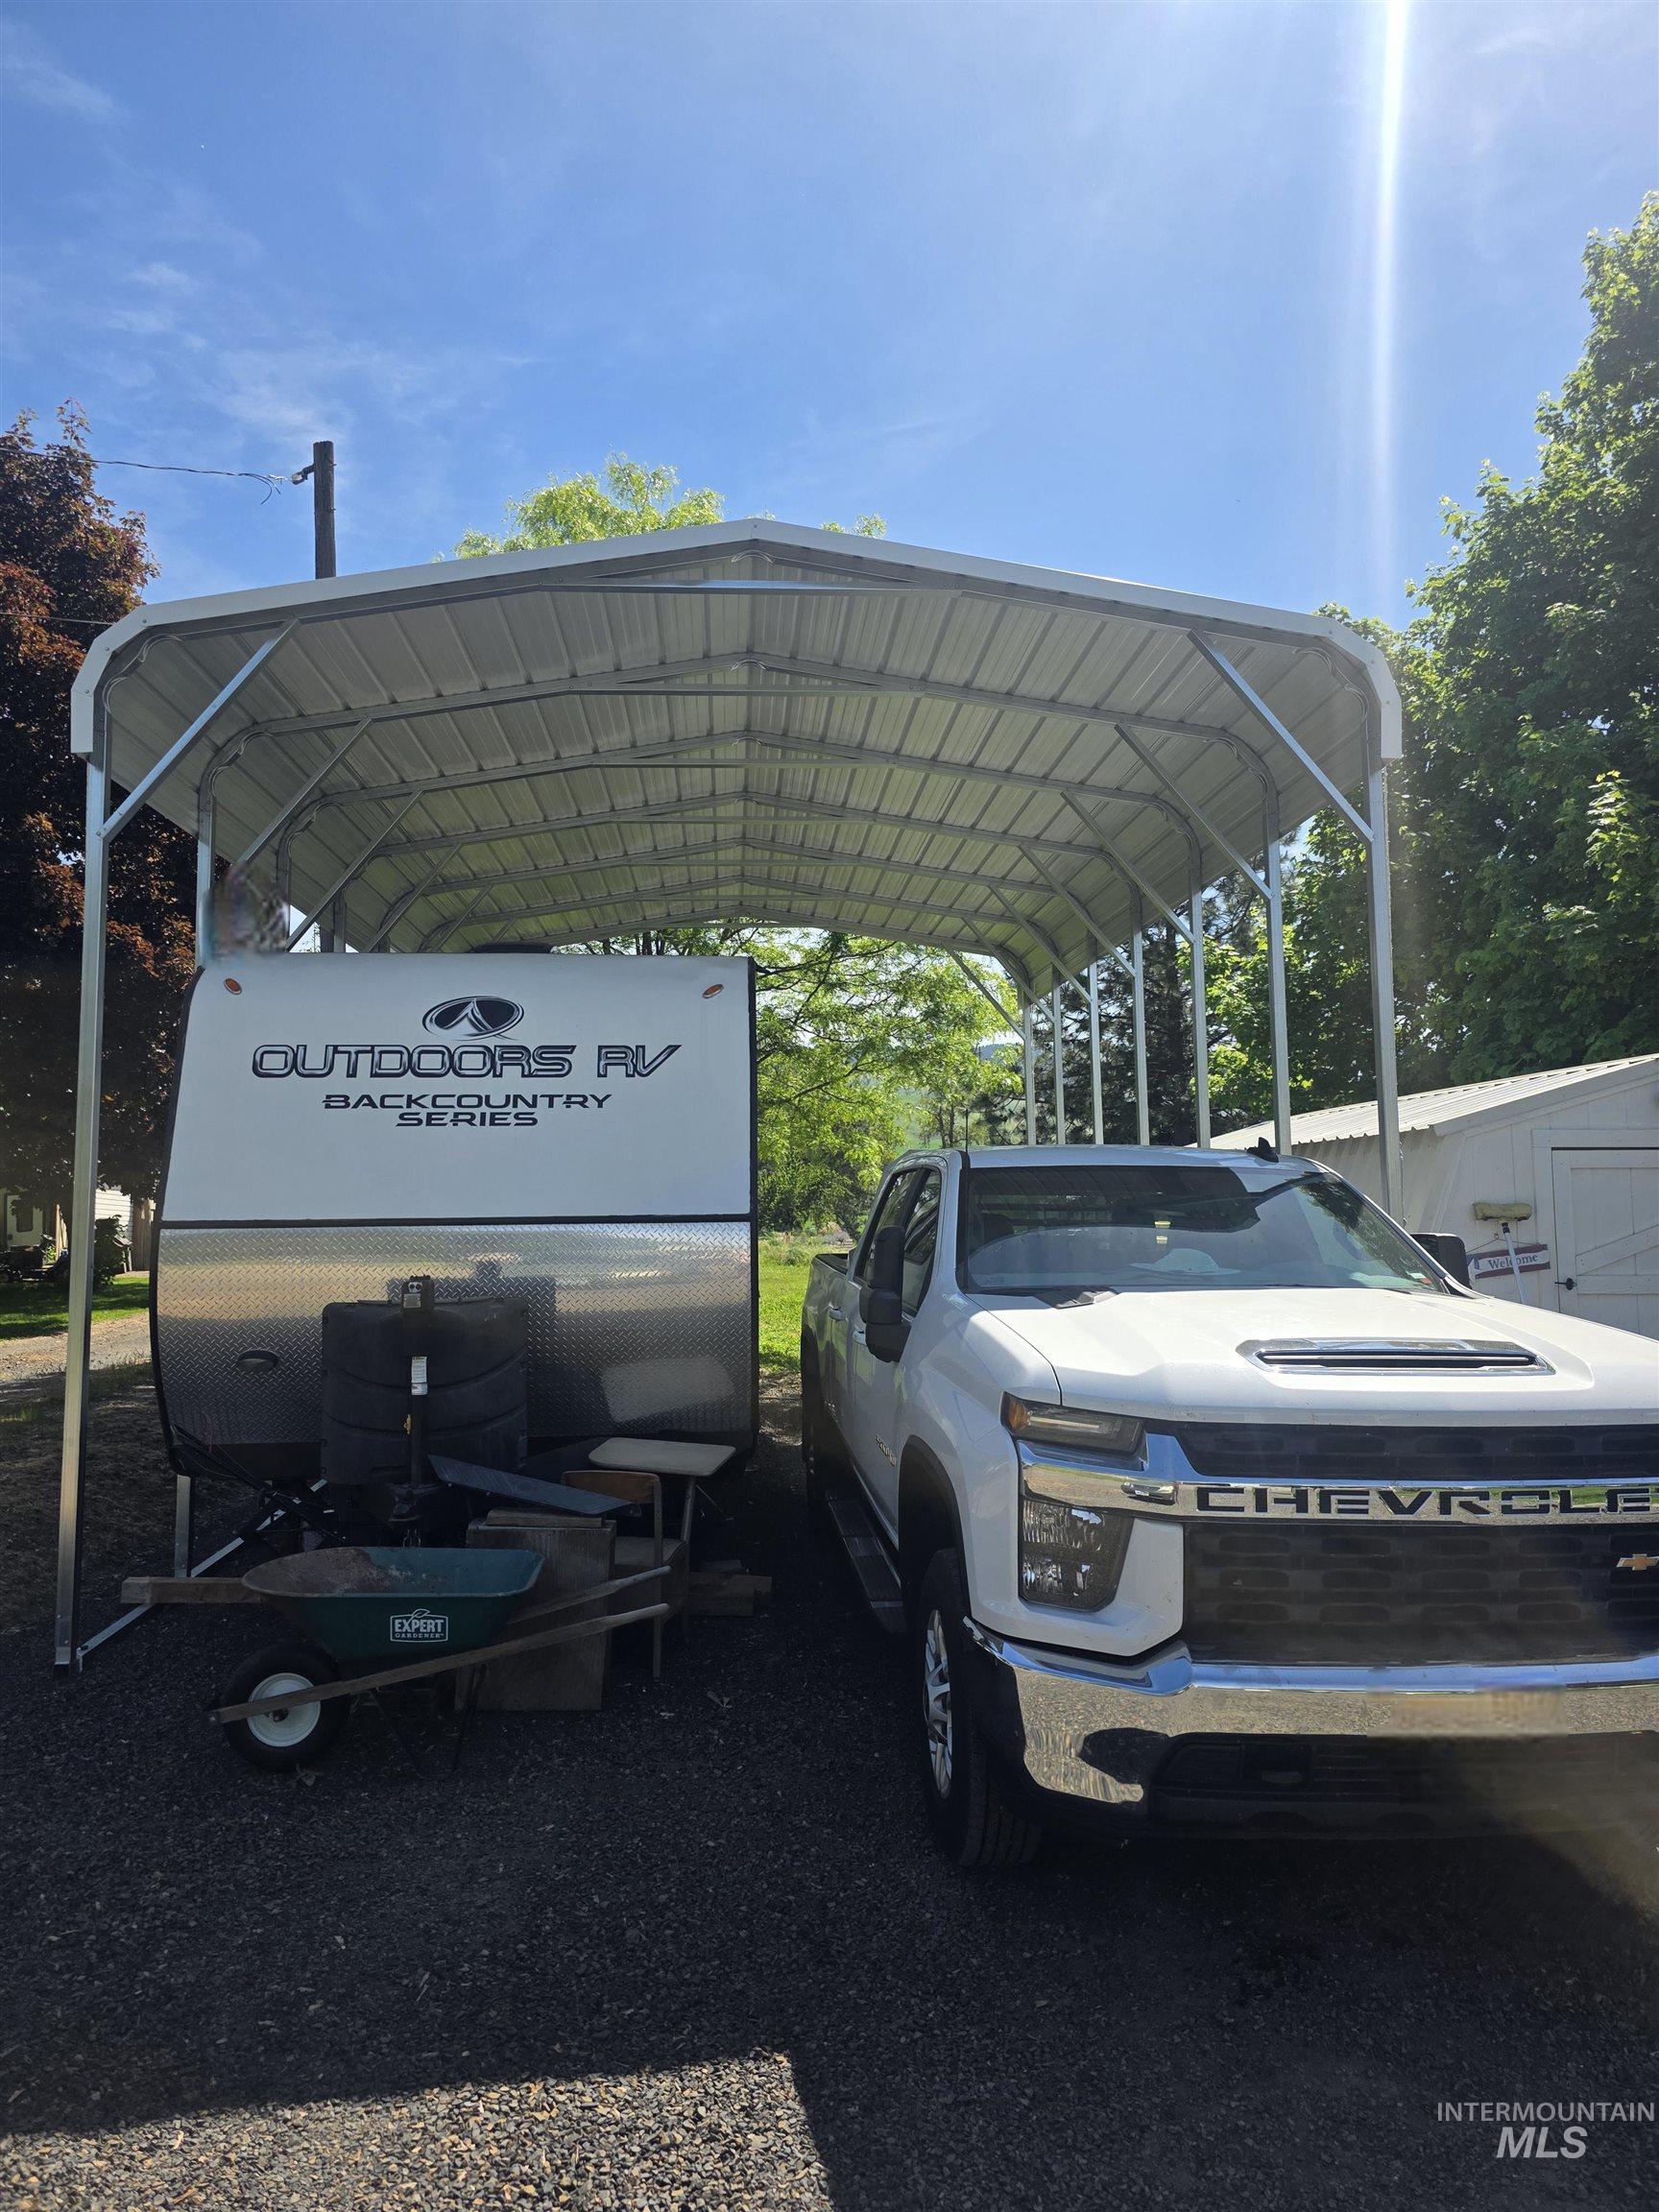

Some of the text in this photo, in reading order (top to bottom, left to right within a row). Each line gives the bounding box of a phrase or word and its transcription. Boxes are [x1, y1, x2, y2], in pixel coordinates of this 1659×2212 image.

[252, 1045, 682, 1078] OUTDOORS RV
[322, 1094, 613, 1109] BACKCOUNTRY
[396, 1112, 539, 1126] SERIES
[1196, 1486, 1659, 1515] CHEVROLE
[395, 1620, 445, 1633] EXPERT
